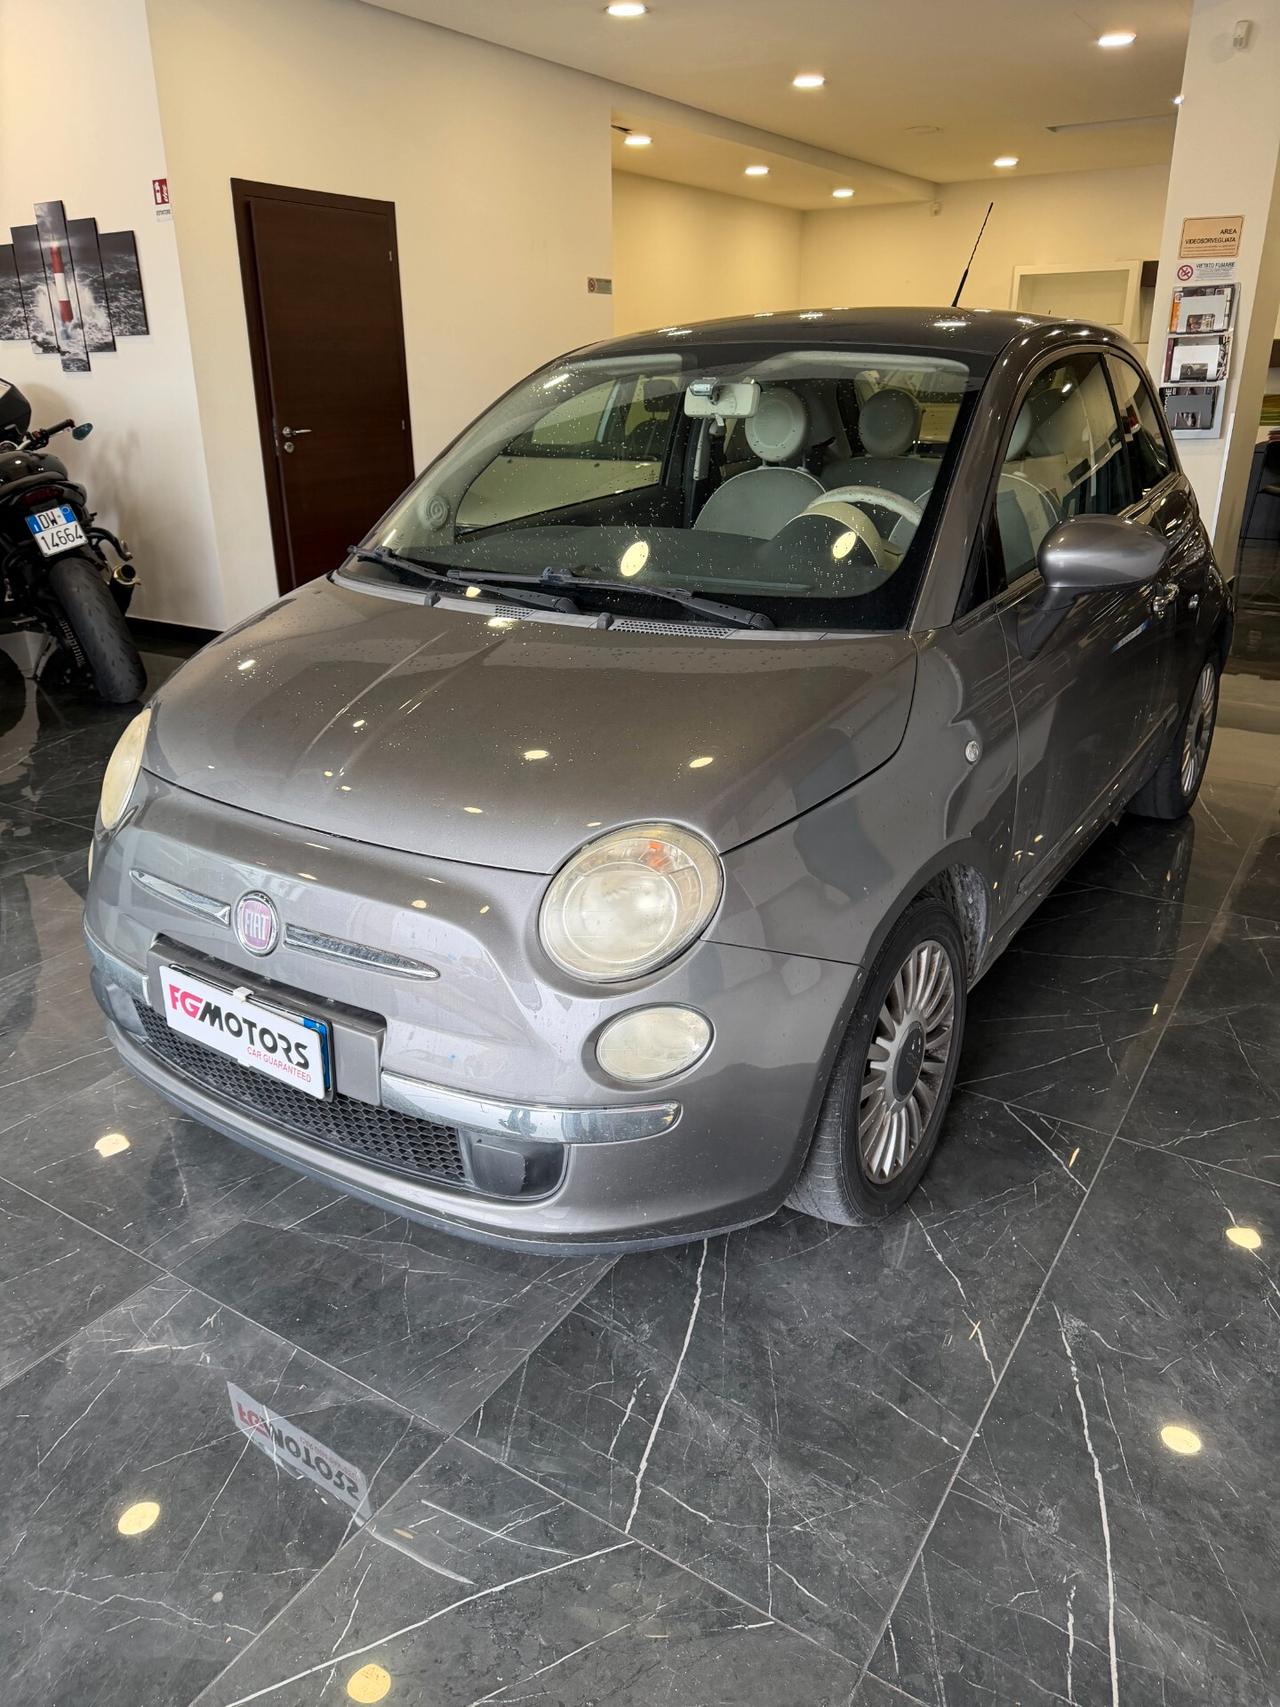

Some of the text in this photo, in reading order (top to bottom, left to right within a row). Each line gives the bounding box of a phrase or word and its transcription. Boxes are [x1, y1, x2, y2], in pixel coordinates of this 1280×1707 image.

[38, 510, 58, 529] DW
[41, 524, 83, 551] 14664
[244, 907, 270, 941] FIAT
[246, 1045, 312, 1084] CAR GUARANTEED
